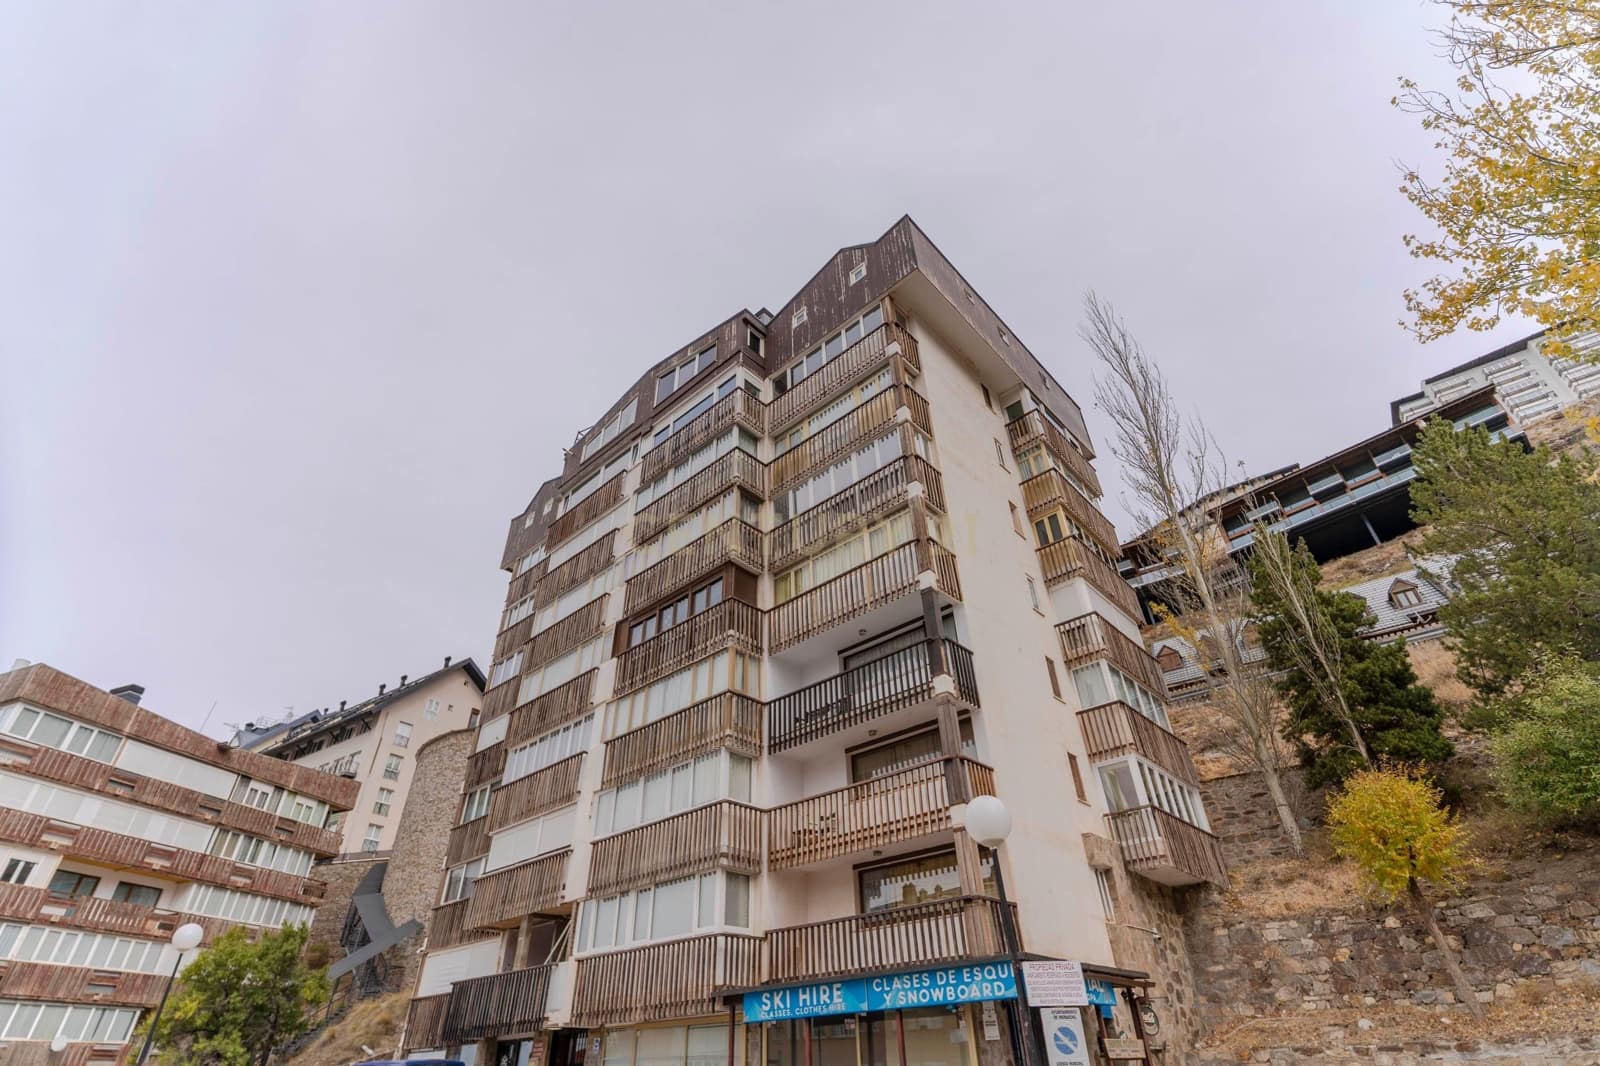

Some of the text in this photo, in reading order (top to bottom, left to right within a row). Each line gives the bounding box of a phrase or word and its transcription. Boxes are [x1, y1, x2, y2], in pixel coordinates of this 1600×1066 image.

[872, 963, 1015, 992] CLASES DE ESQUI
[761, 983, 843, 1012] SKI HIRE
[883, 981, 1006, 1006] Y SNOWBOARD
[795, 1004, 827, 1016] CLOTHES
